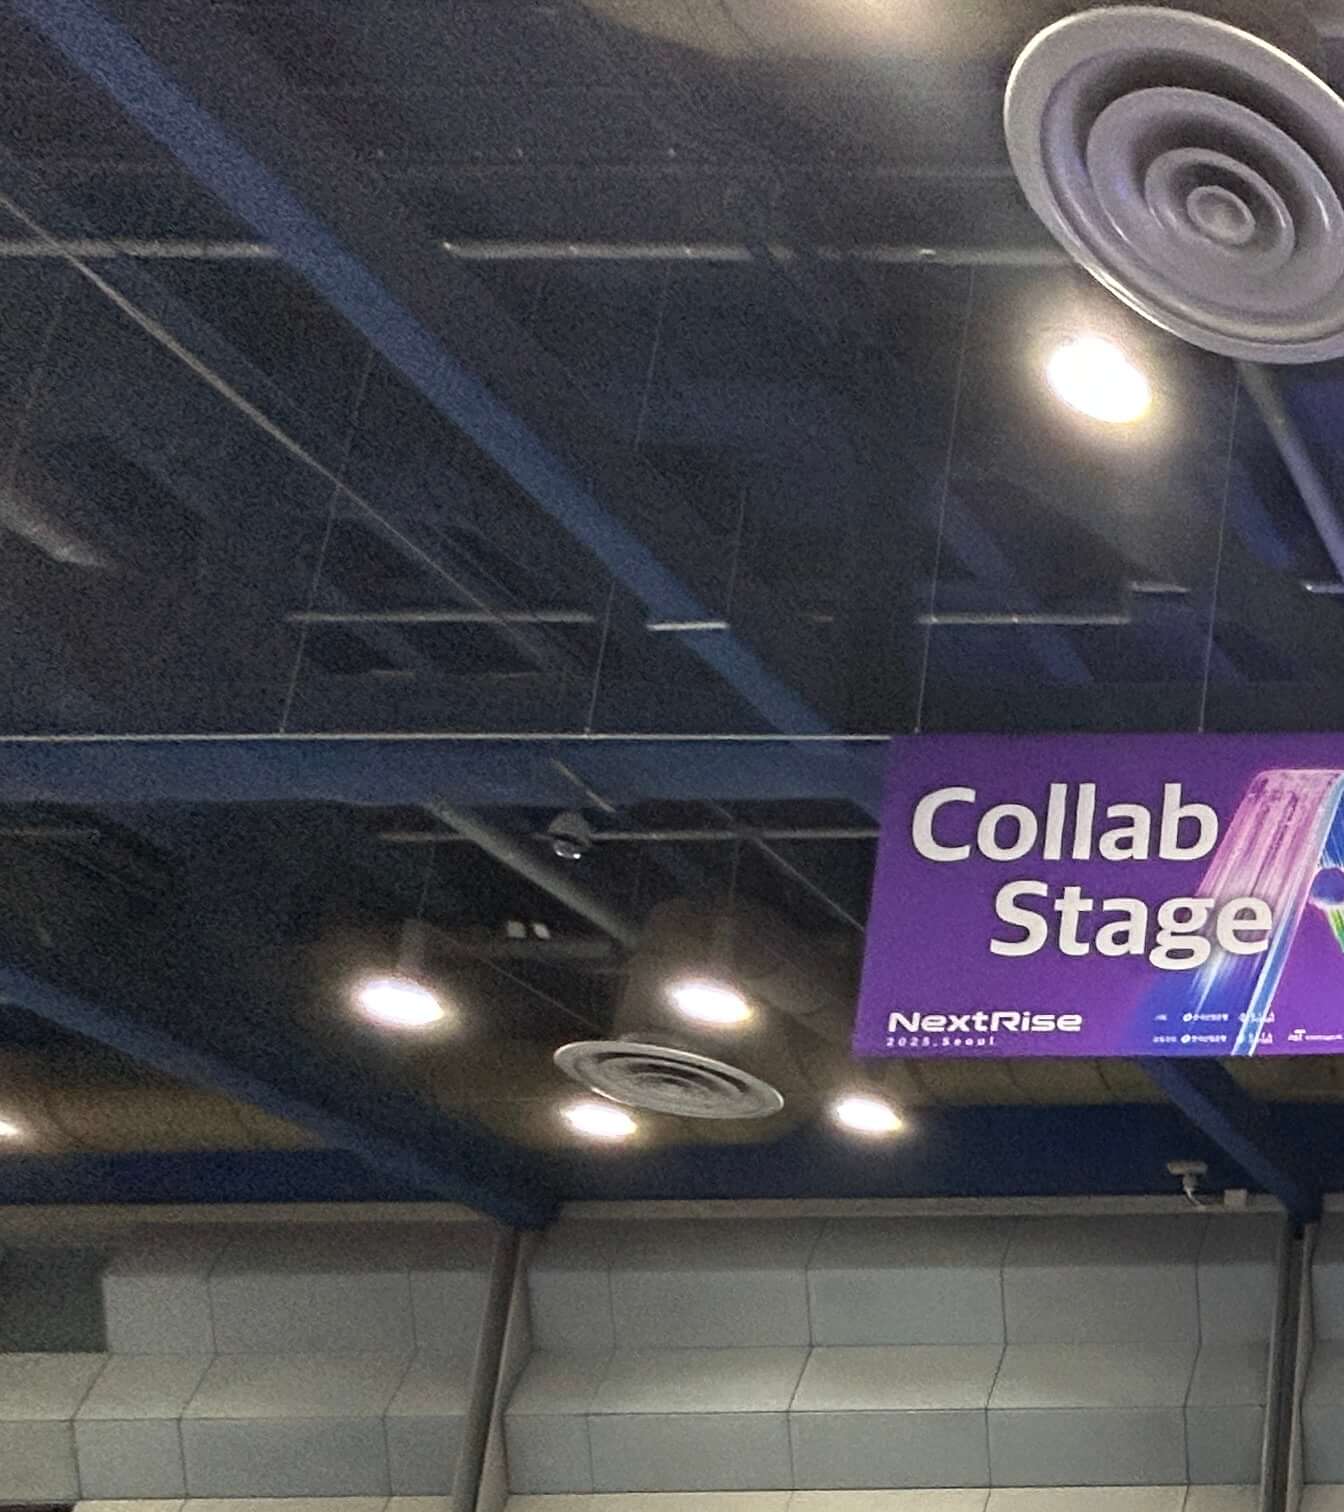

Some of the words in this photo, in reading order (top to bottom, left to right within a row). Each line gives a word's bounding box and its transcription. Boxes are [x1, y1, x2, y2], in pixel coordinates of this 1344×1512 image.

[912, 782, 1219, 863] Collab
[990, 879, 1274, 972] Stage
[888, 1011, 1083, 1032] NextRise
